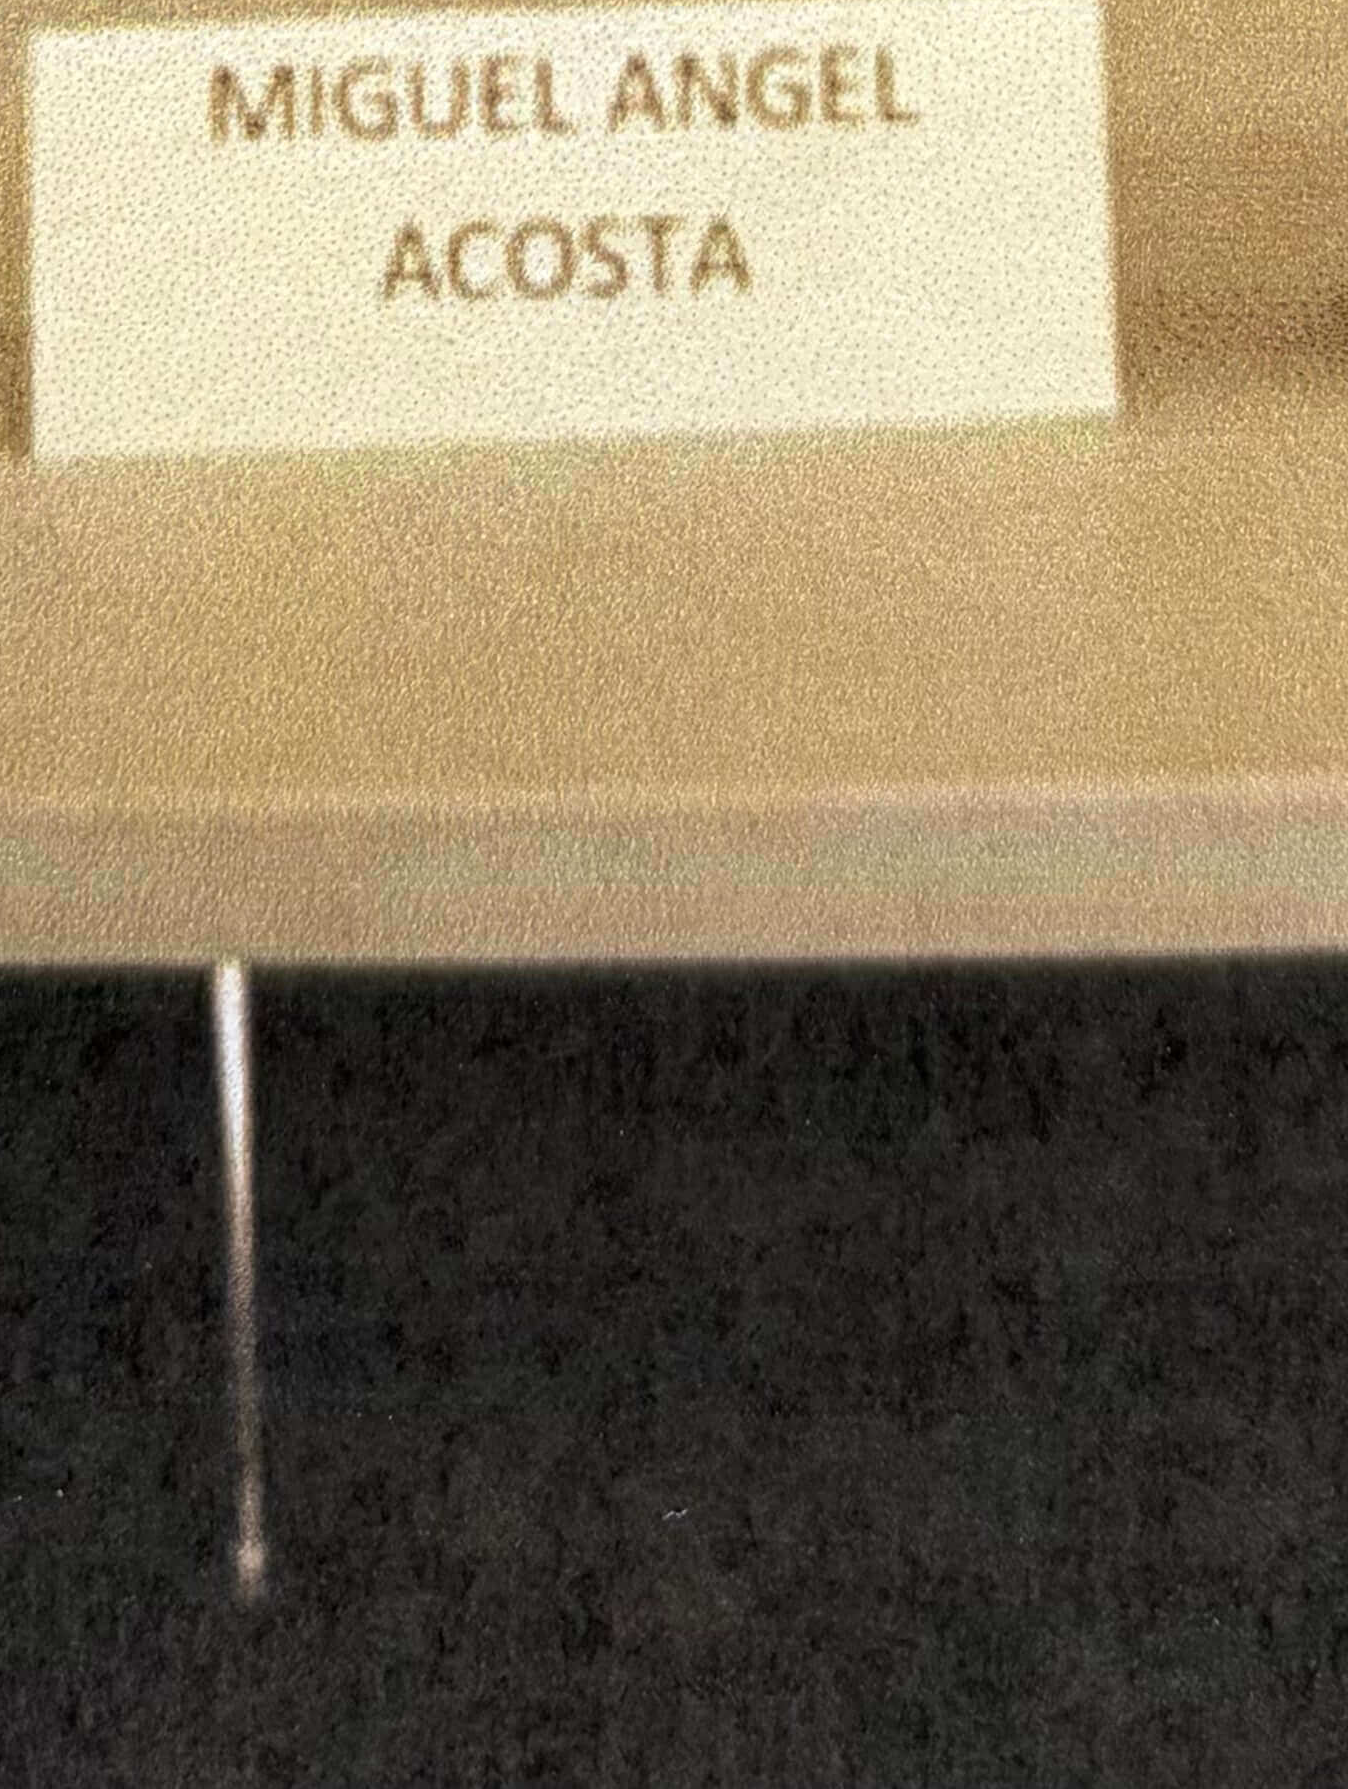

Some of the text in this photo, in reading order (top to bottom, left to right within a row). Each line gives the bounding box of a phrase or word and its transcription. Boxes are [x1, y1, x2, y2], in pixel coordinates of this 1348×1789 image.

[207, 41, 922, 144] MIGUEL ANGEL
[380, 214, 756, 304] ACOSTA
